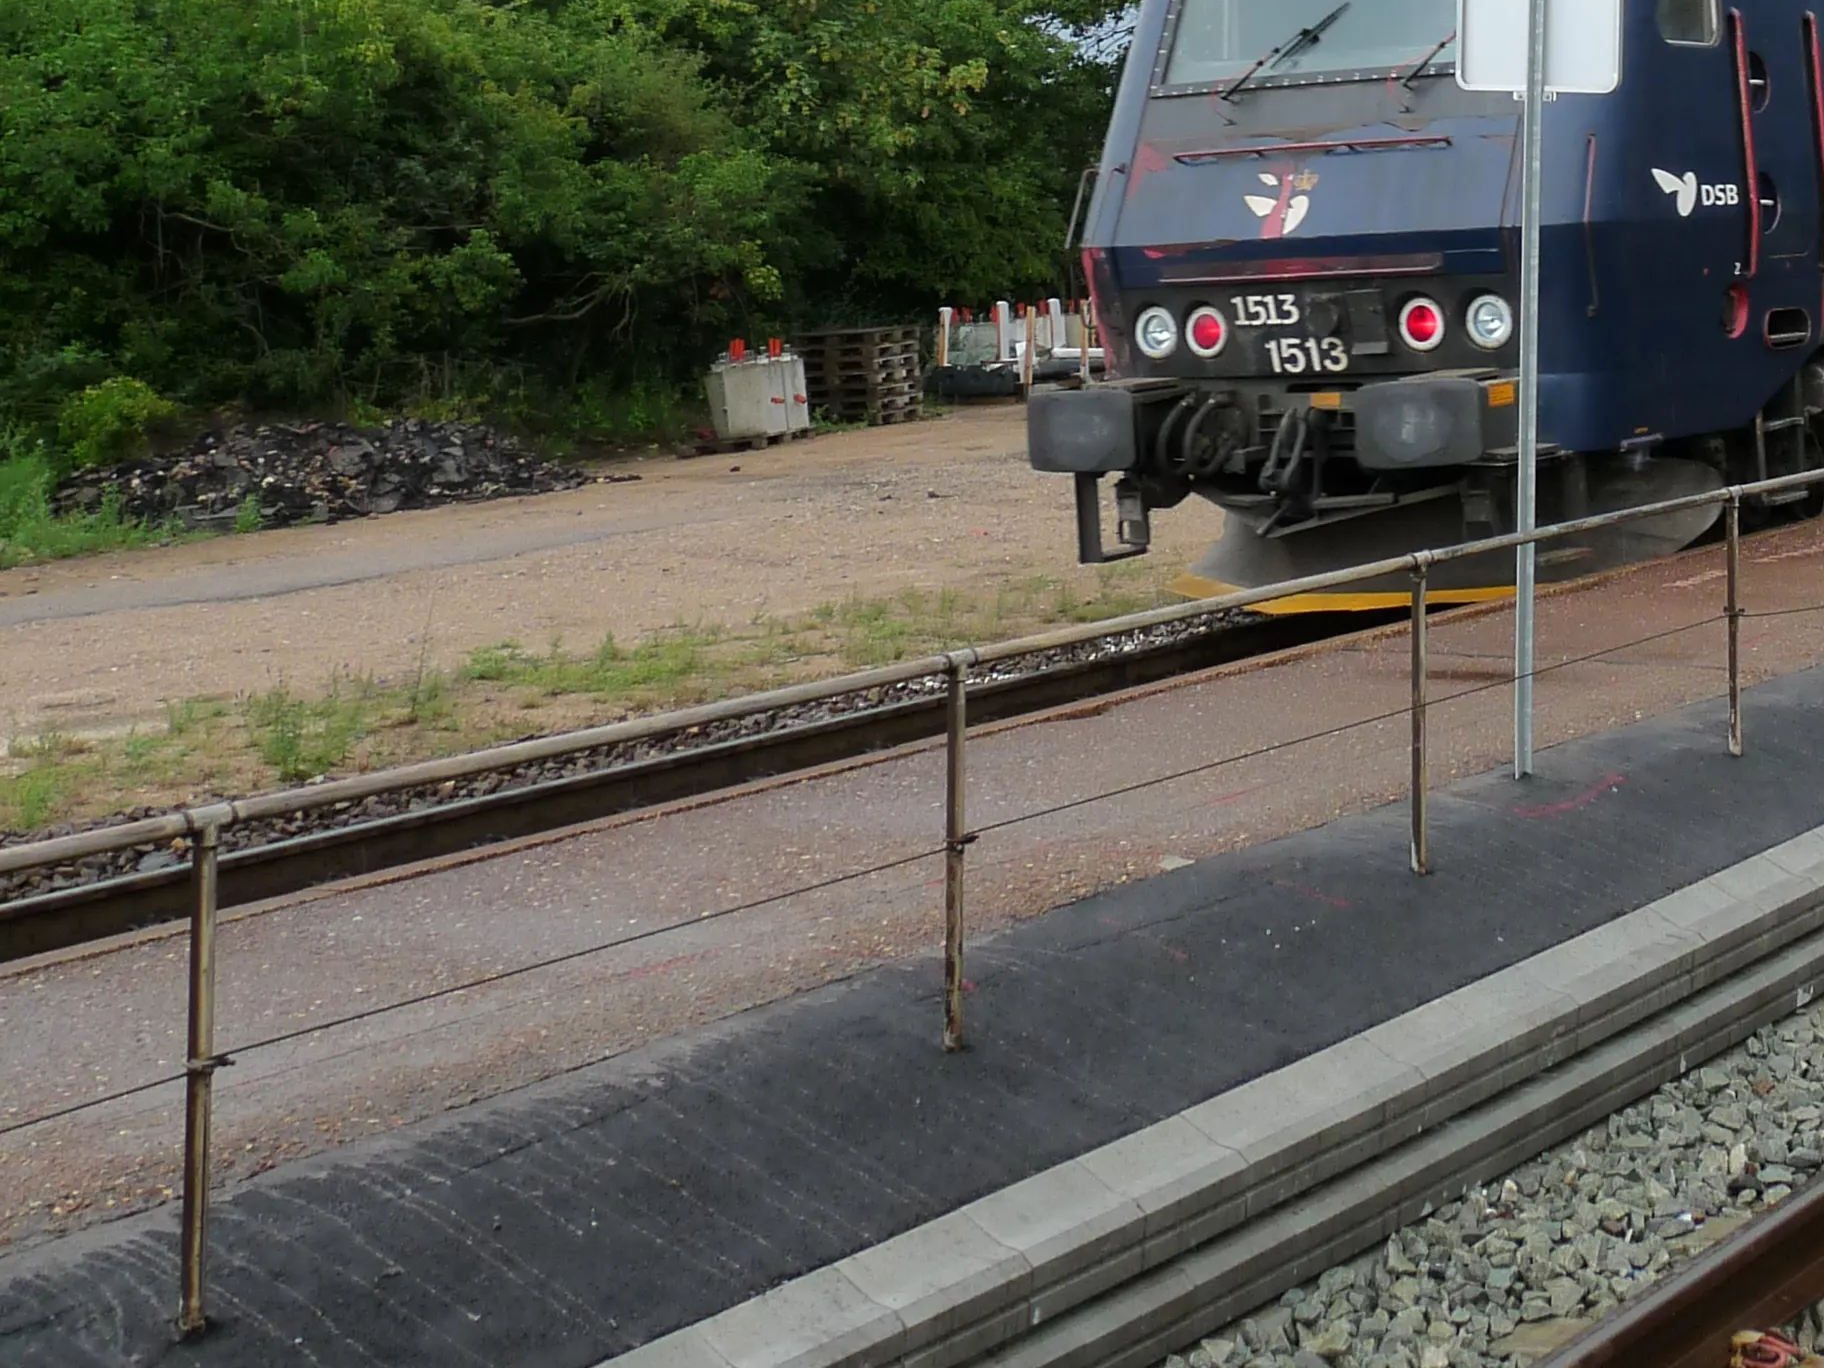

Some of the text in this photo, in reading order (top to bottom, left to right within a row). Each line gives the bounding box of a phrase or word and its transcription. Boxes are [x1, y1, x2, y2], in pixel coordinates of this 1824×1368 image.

[1700, 184, 1739, 206] DSB
[1230, 294, 1300, 326] 1513
[1264, 337, 1349, 373] 1513
